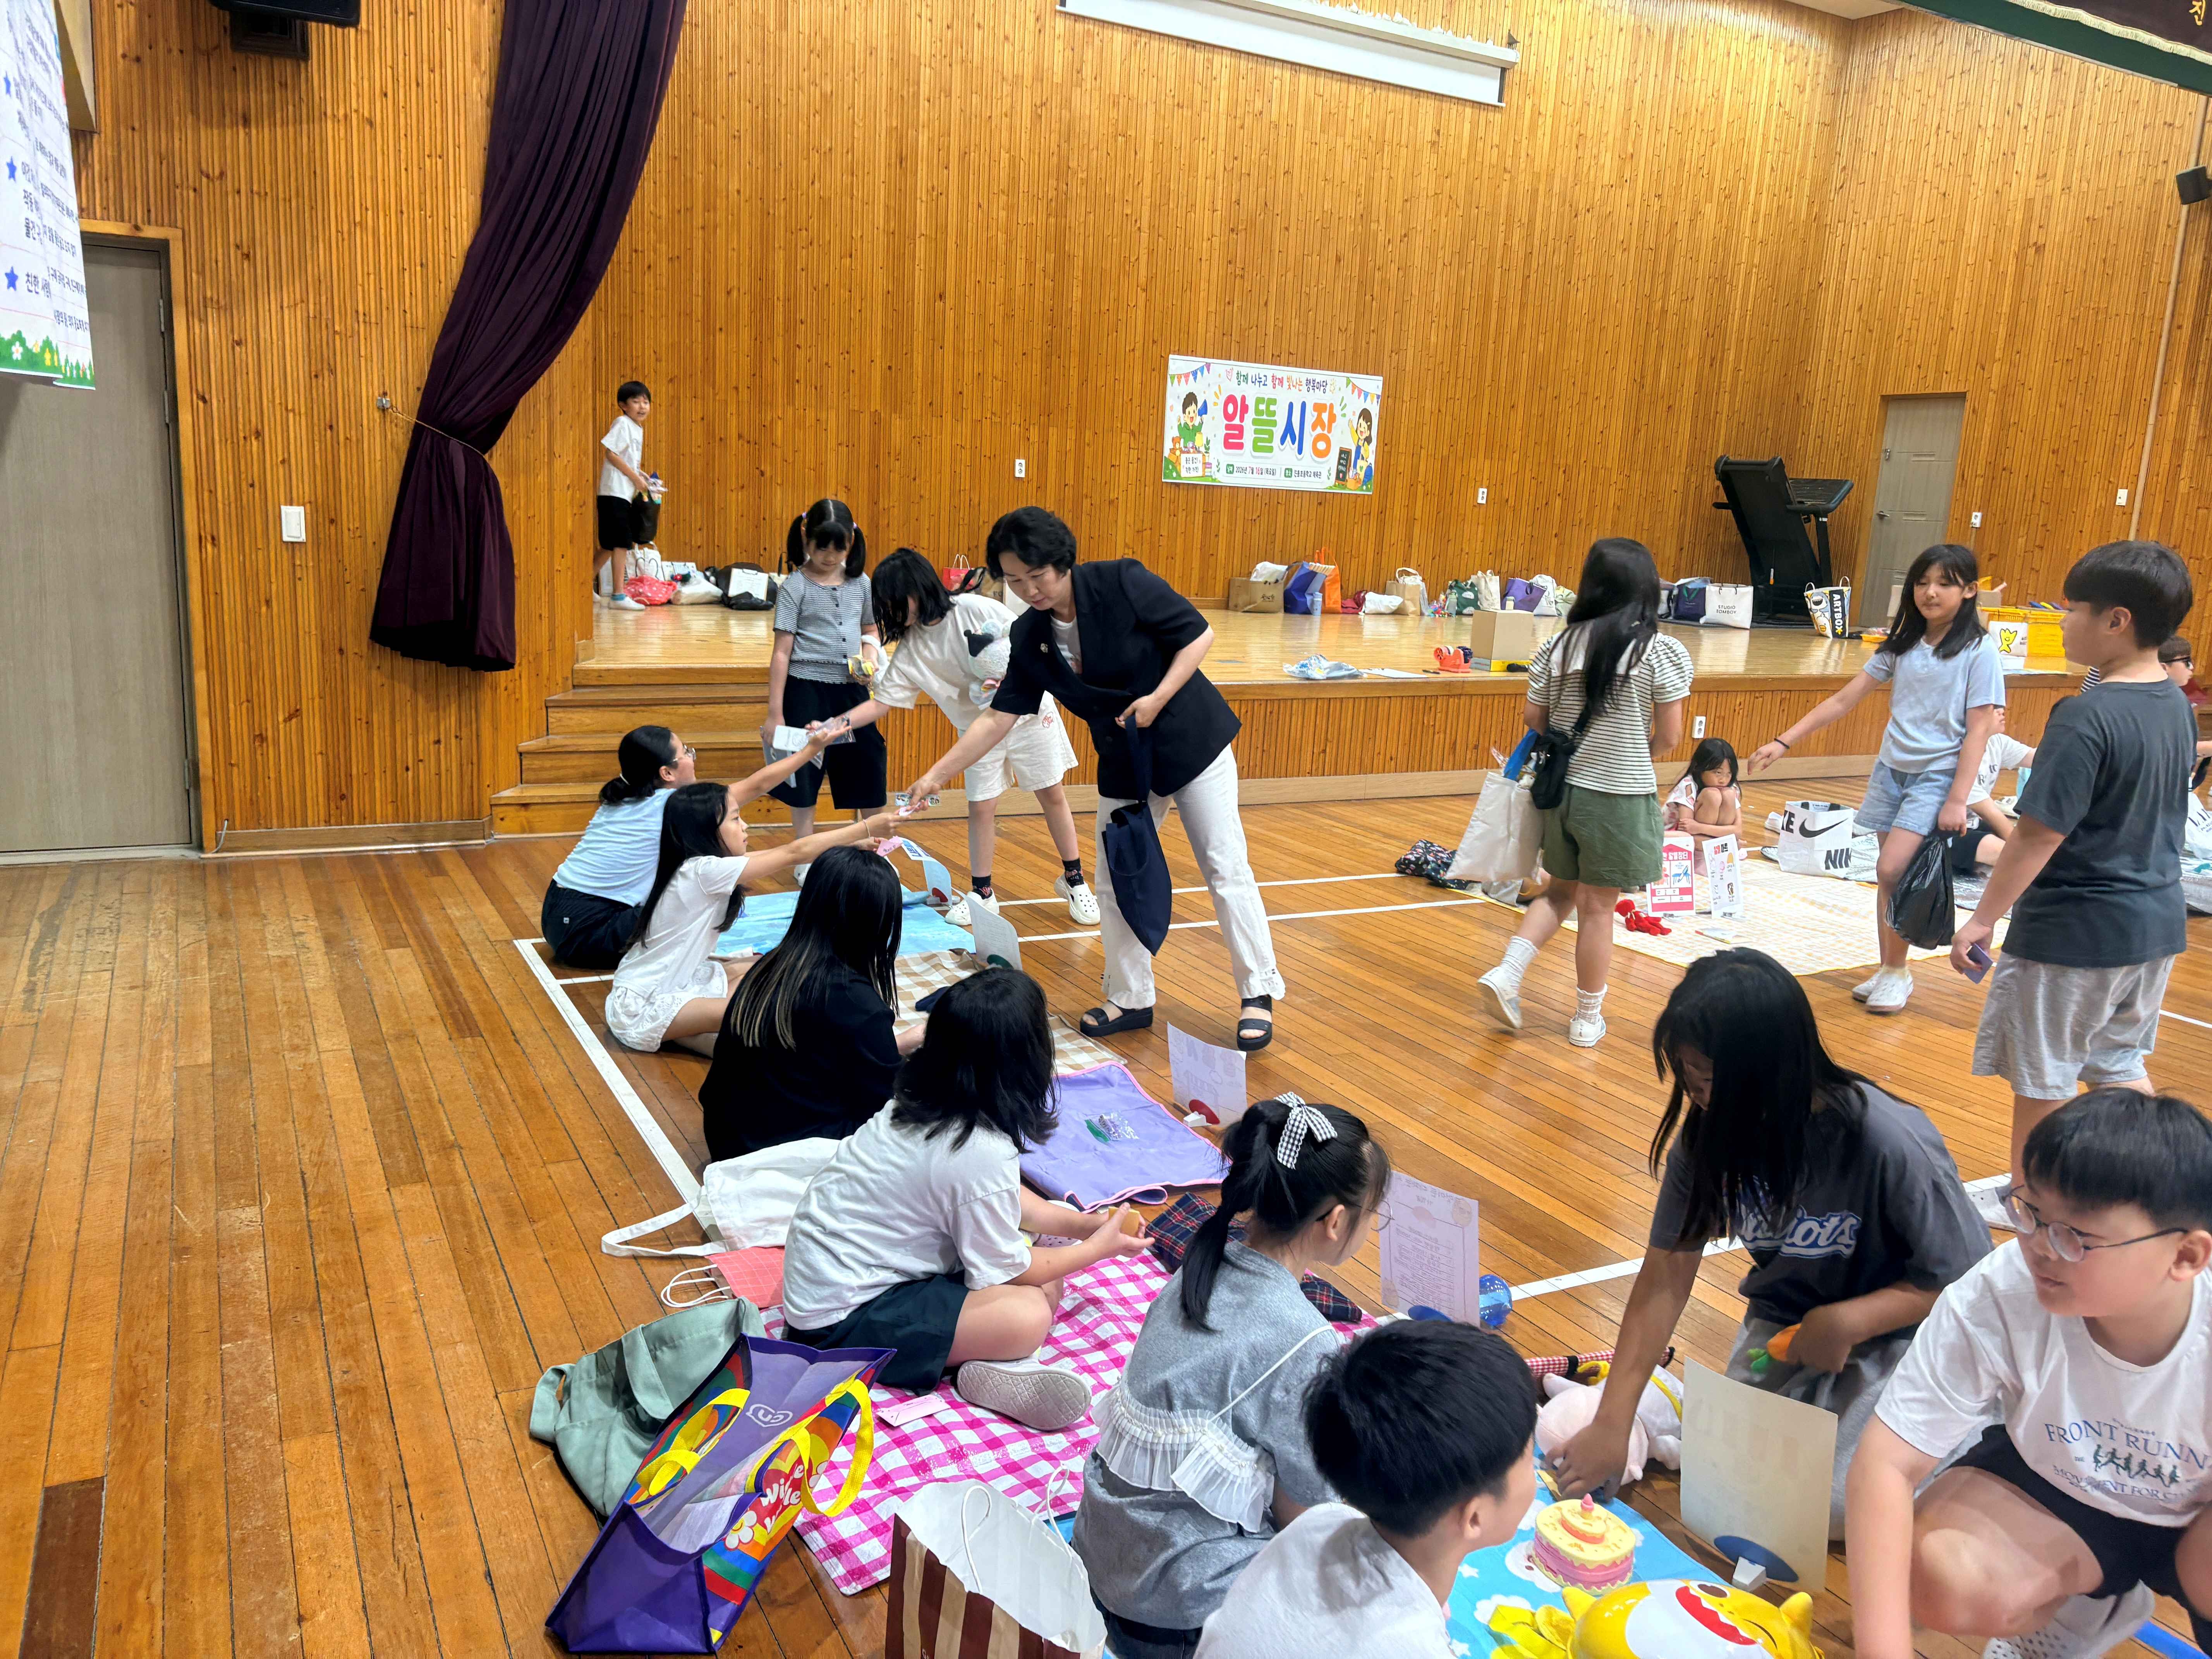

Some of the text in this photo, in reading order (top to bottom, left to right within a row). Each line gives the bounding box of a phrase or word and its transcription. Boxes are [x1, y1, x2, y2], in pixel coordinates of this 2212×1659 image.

[2189, 0, 2206, 26] 진
[1236, 370, 1328, 393] 함께 나누고 함께 빛나는 행복마당
[1223, 394, 1336, 458] 알뜰시장
[1236, 466, 1247, 474] 2026년
[1249, 467, 1254, 475] 7월
[1832, 594, 1843, 635] ARTBOX
[2044, 1420, 2118, 1443] FRONT
[2131, 1485, 2160, 1498] FOR
